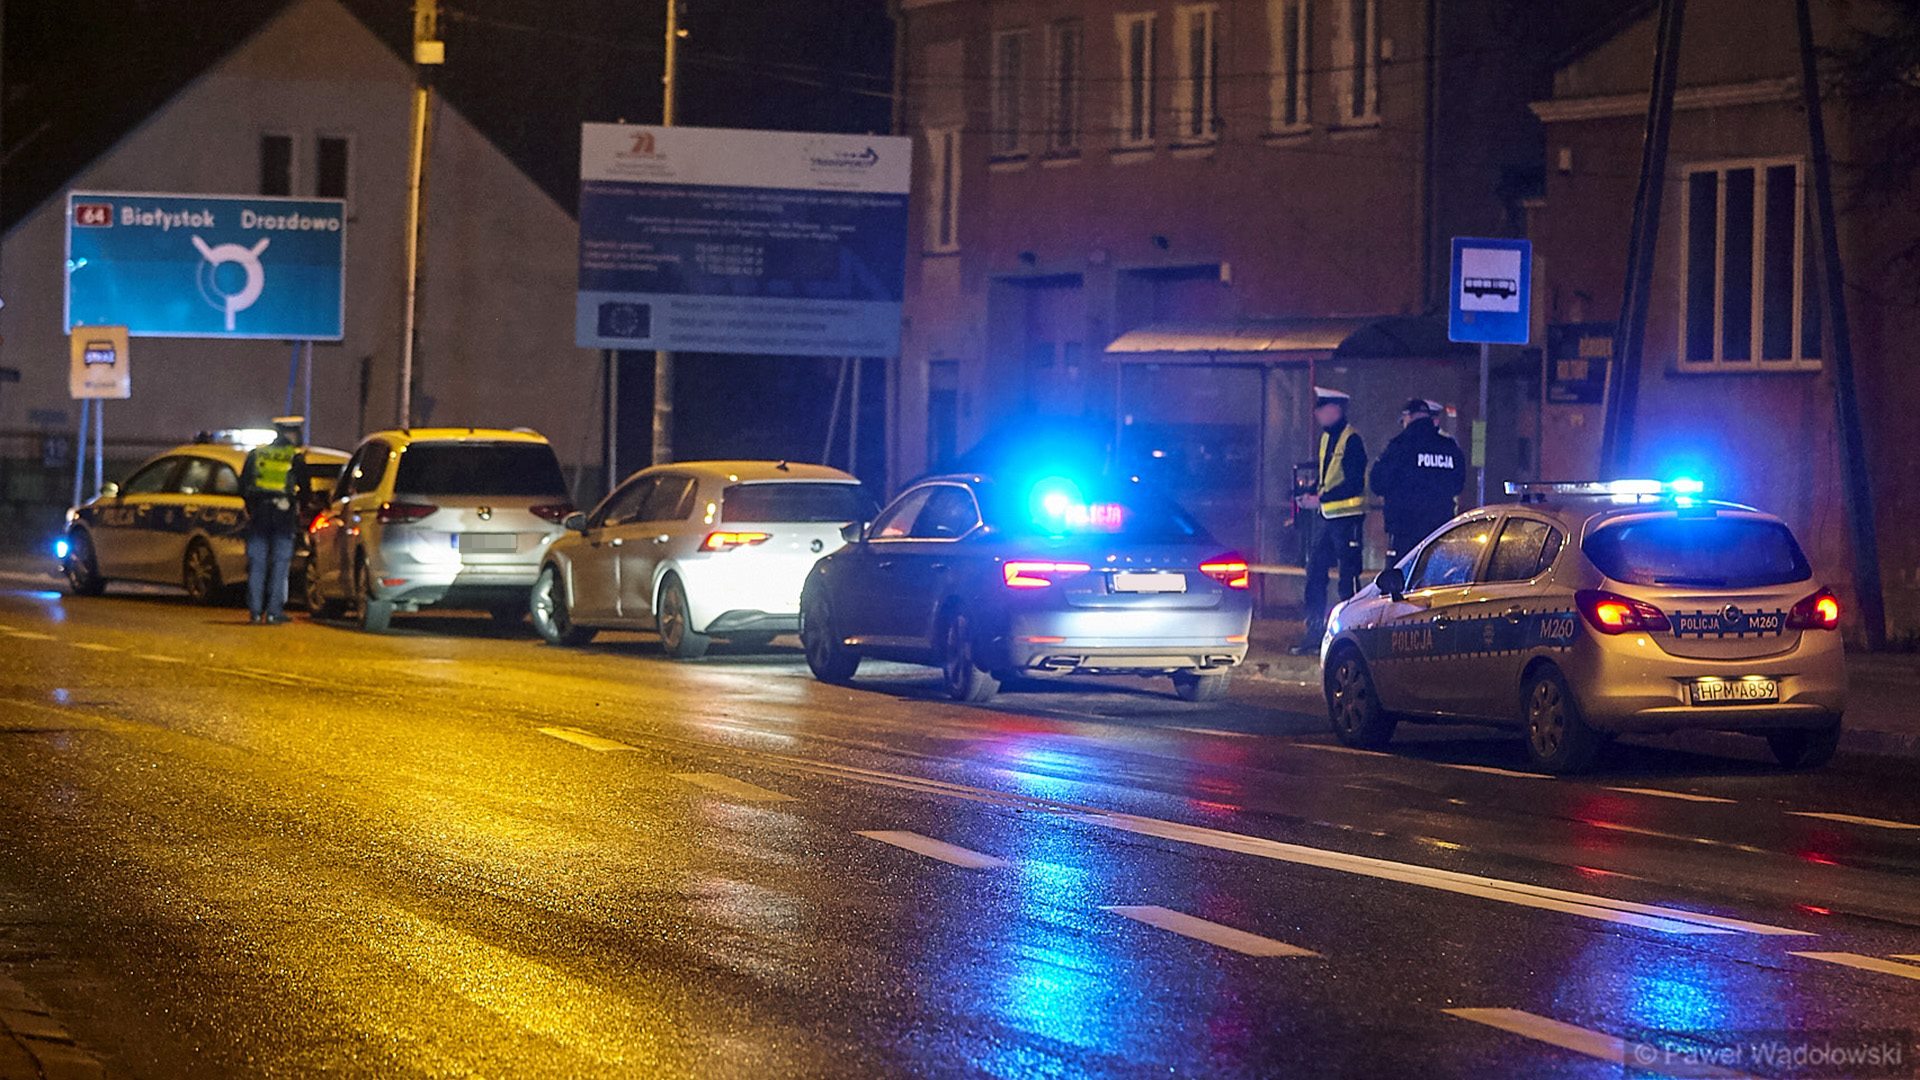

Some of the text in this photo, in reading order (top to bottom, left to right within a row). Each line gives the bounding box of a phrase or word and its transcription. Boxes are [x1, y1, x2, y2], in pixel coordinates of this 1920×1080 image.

[83, 207, 106, 225] 64
[121, 205, 341, 232] Białystok Drozdowo
[1417, 452, 1455, 470] POLICJA
[1680, 616, 1779, 631] POLICJA M260
[1391, 619, 1574, 650] POLICJA M260
[1700, 682, 1776, 700] HPM A859
